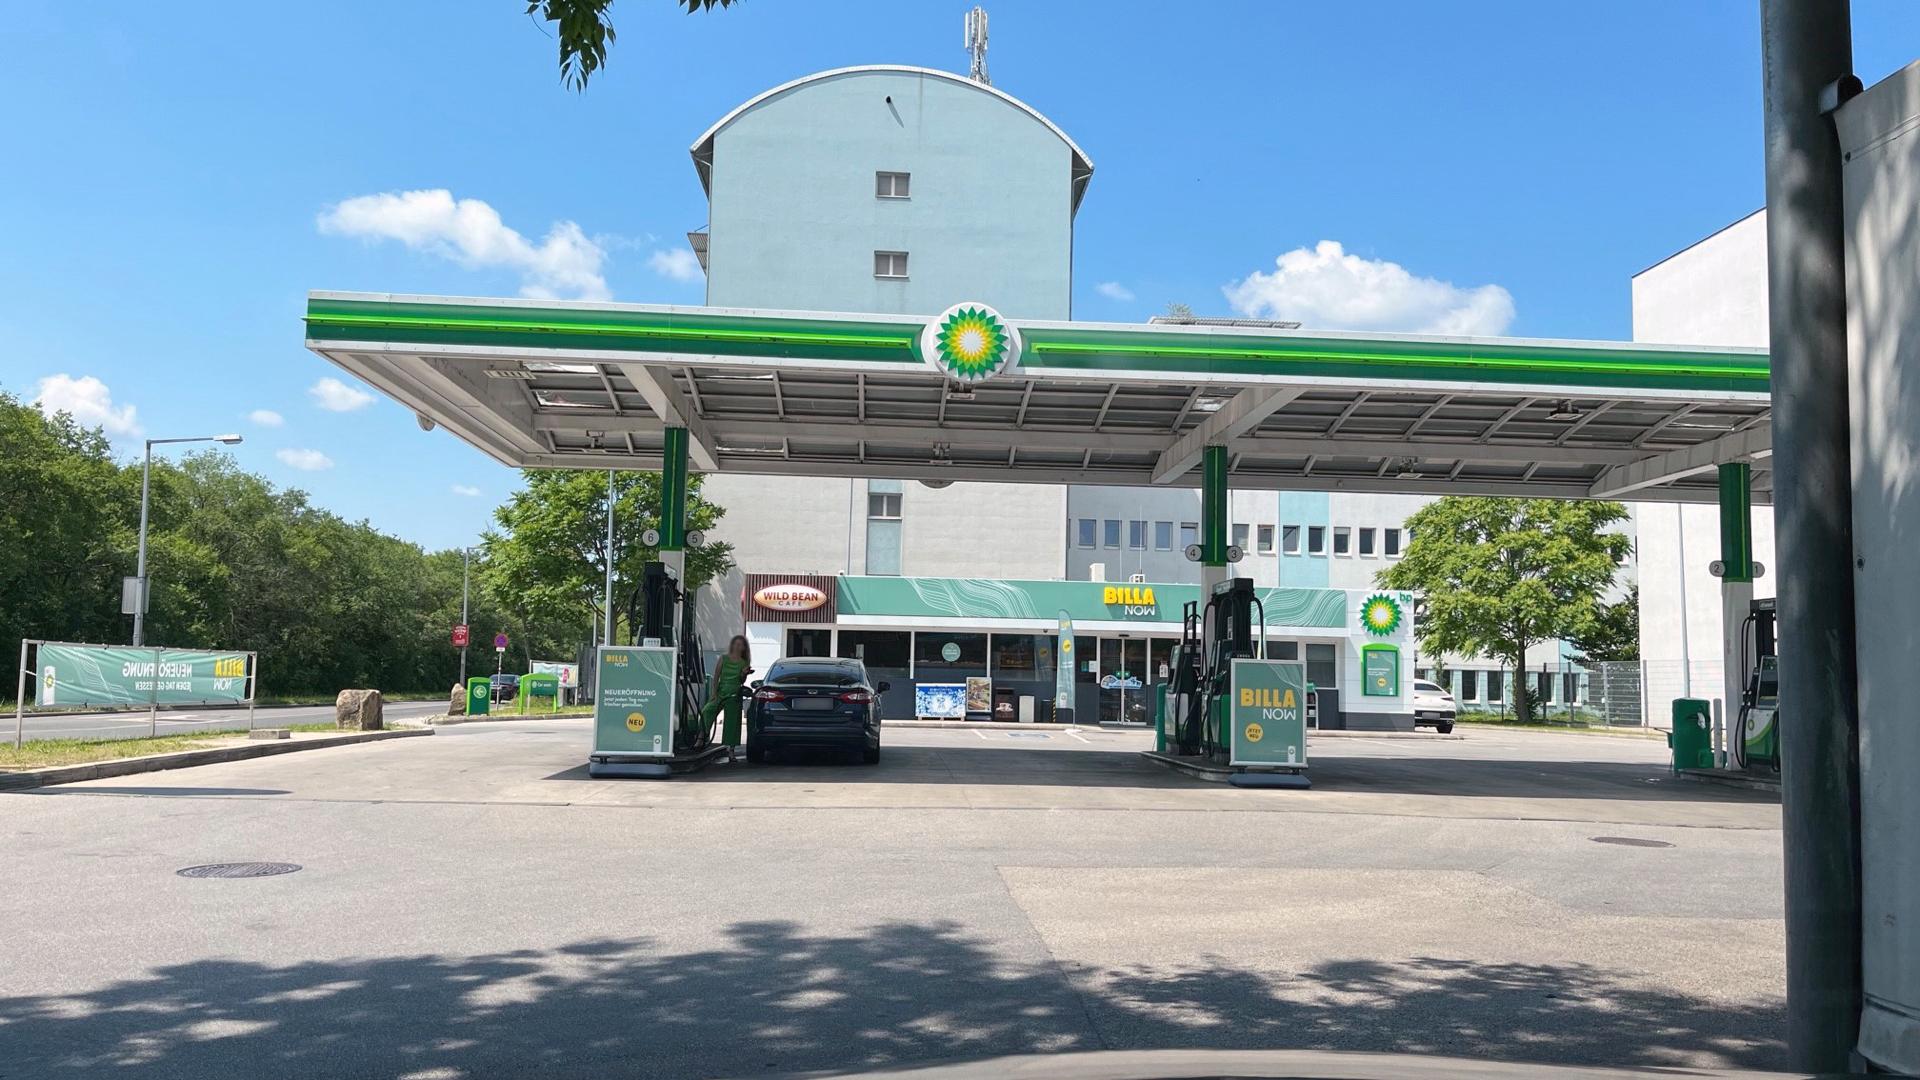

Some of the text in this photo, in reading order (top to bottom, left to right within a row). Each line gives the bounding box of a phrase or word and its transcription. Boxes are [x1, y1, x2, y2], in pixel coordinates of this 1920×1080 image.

[648, 533, 654, 542] 6
[692, 534, 698, 543] 5
[1190, 549, 1196, 557] 4
[1231, 550, 1237, 558] 3
[1714, 564, 1720, 573] 2
[764, 592, 818, 601] WILD BEAN
[1104, 586, 1155, 605] BILLA
[1399, 592, 1412, 603] bp
[1124, 606, 1156, 616] NOW
[604, 688, 657, 697] NEUERÖFFNUNG
[1240, 687, 1296, 708] BILLA
[1262, 708, 1296, 721] NOW
[628, 718, 644, 726] NEU
